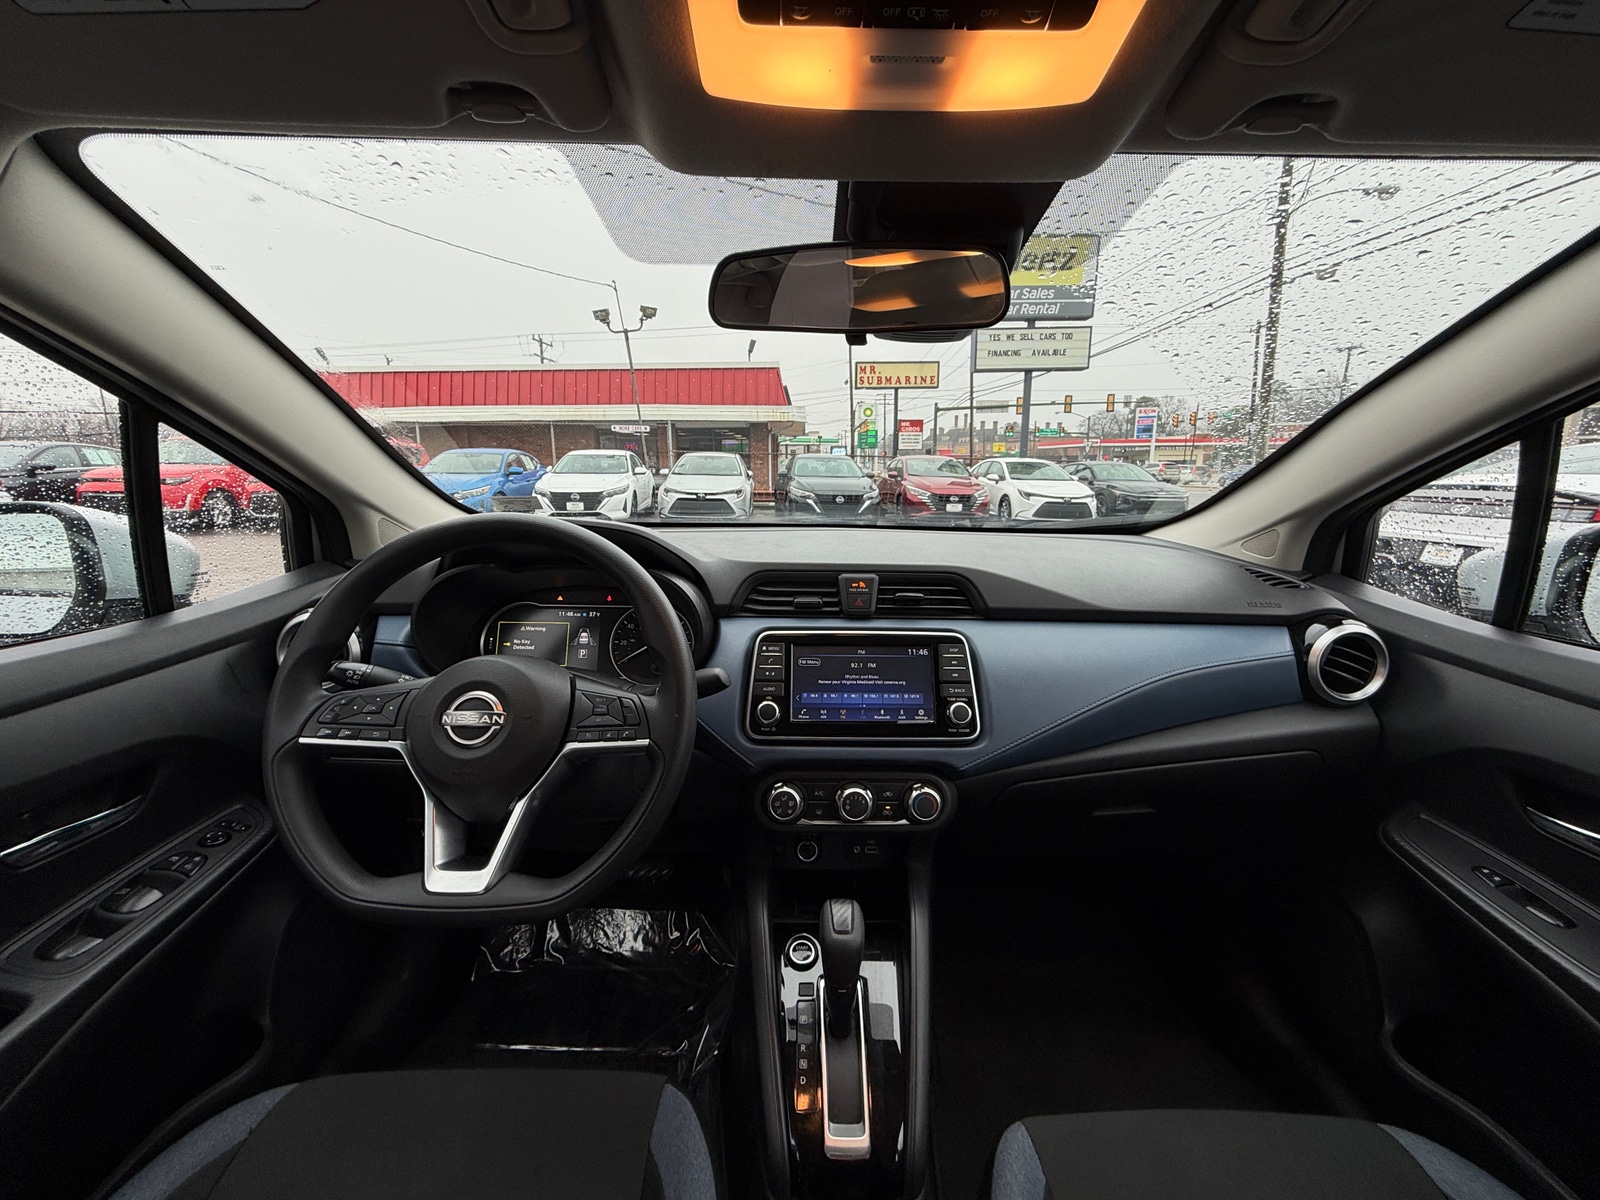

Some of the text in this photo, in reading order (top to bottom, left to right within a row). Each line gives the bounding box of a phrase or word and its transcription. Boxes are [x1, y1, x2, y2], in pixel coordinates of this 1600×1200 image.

[883, 7, 901, 16] OFF
[980, 9, 1000, 18] OFF
[1021, 288, 1055, 299] Sales
[1020, 303, 1060, 315] Rental
[988, 333, 1001, 341] YES
[1006, 333, 1015, 341] WE
[1020, 333, 1034, 341] SELL
[1061, 332, 1073, 340] TOO
[987, 348, 1067, 358] FINANCING AVAILABLE
[859, 365, 881, 375] MR.
[858, 375, 936, 386] SUBMARINE
[441, 714, 505, 724] NISSAN
[800, 1044, 806, 1052] R
[800, 1076, 806, 1084] D
